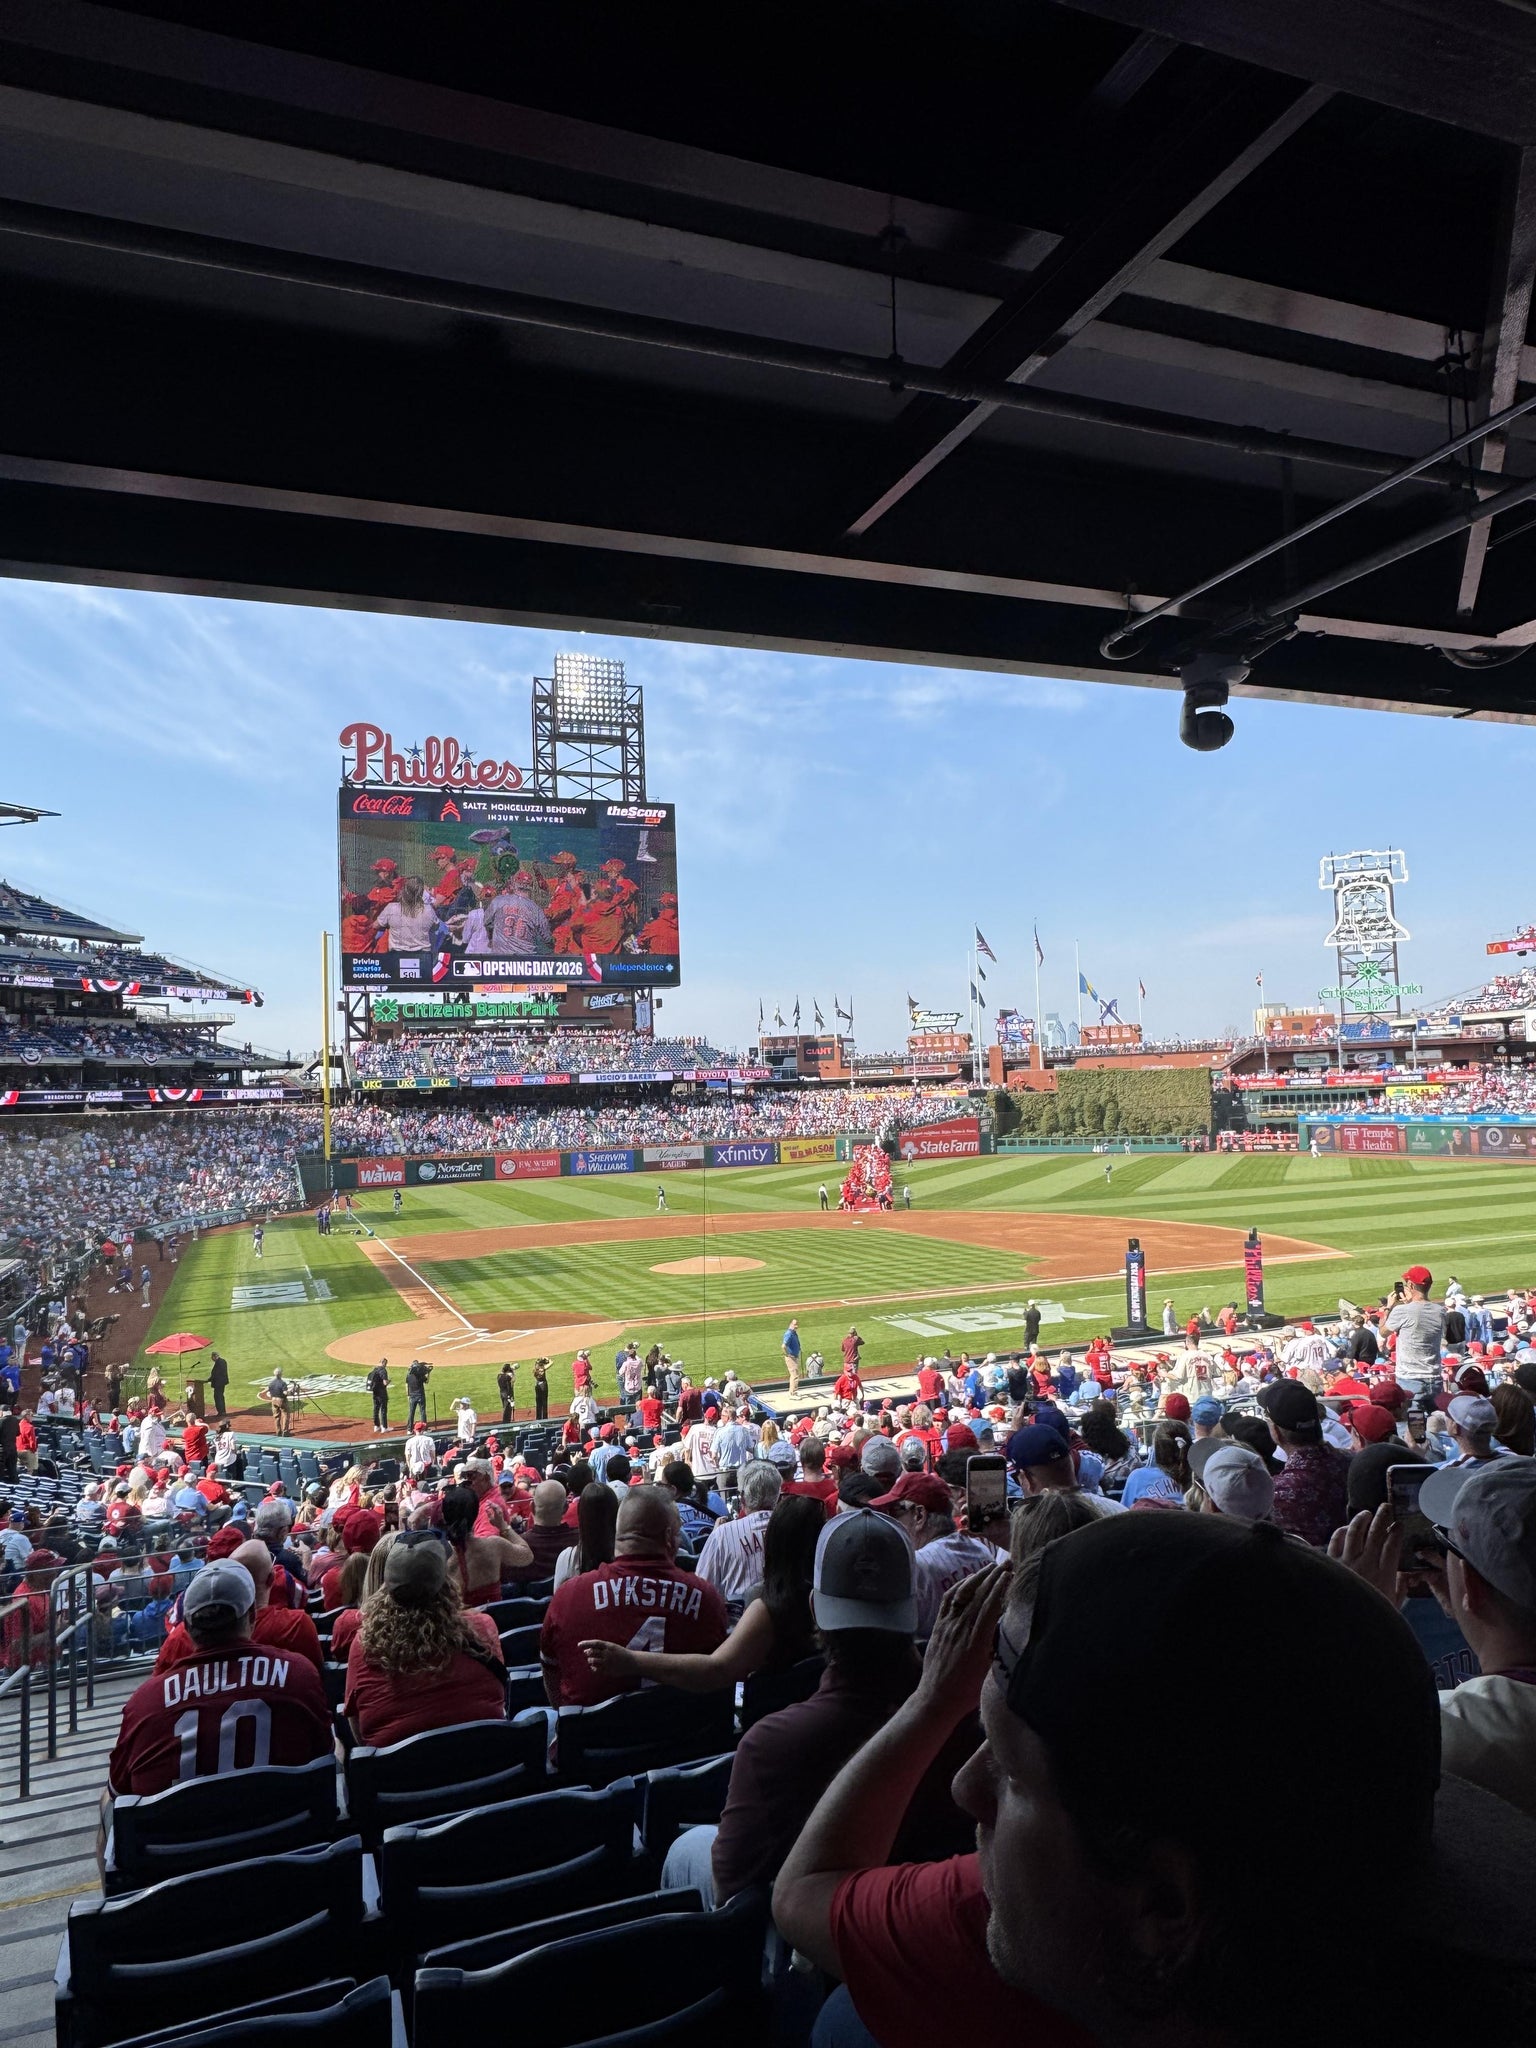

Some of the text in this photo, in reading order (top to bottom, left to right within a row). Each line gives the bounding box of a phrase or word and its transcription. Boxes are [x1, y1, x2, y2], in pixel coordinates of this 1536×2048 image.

[339, 722, 523, 790] Phillies
[463, 802, 487, 810] SALTZ
[546, 804, 586, 814] BENDESKY
[607, 806, 667, 818] theScore
[488, 814, 564, 824] INJURY LAWYERS
[483, 961, 583, 976] OPENING DAY 2026
[590, 993, 616, 1009] GHOST
[402, 1001, 560, 1017] Citizens Bank Park
[806, 1047, 833, 1055] GIANT
[743, 1069, 770, 1077] TOYOTA
[362, 1080, 382, 1089] UKG
[397, 1080, 416, 1088] UKG
[431, 1078, 450, 1087] UKG
[1361, 1128, 1394, 1139] Temple
[920, 1140, 978, 1154] State Farm
[1362, 1140, 1393, 1151] Health
[588, 1152, 627, 1163] SHERWIN
[717, 1145, 768, 1163] xfinity
[438, 1162, 483, 1173] NovaCare
[662, 1160, 686, 1168] LAGER
[361, 1170, 402, 1184] Wawa
[580, 1405, 586, 1413] 5
[593, 1576, 702, 1620] DYKSTRA
[164, 1656, 289, 1708] DAULTON
[172, 1698, 271, 1786] 10
